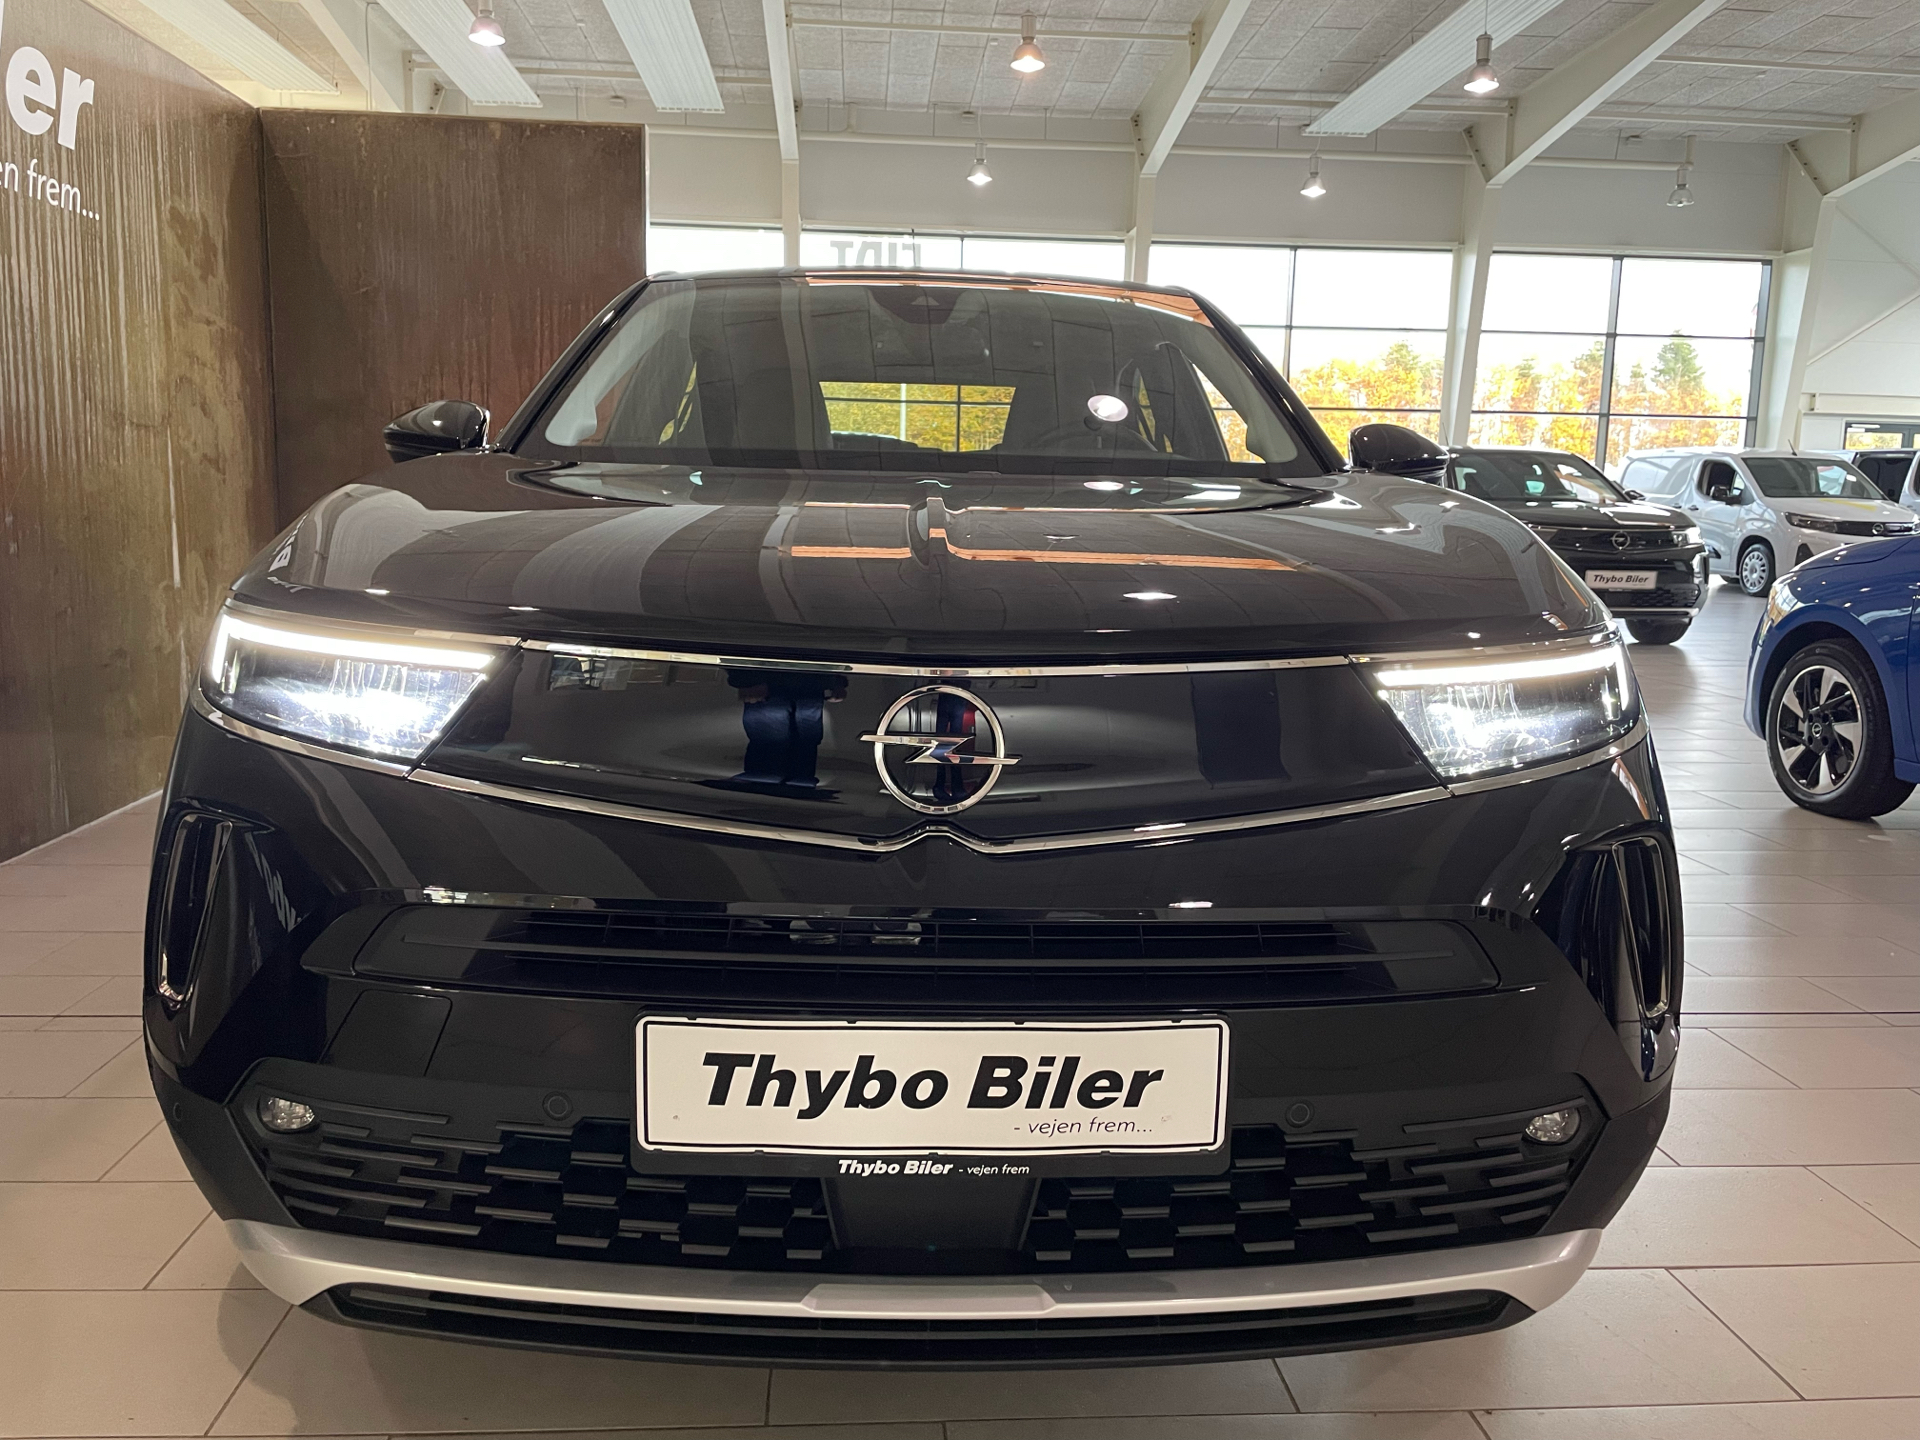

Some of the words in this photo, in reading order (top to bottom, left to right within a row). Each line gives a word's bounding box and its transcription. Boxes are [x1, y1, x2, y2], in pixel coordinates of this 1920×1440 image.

[0, 0, 95, 150] er
[27, 158, 100, 221] frem...
[1593, 574, 1623, 584] Thybo
[1625, 575, 1649, 583] Biler
[702, 1051, 949, 1120] Thybo
[966, 1055, 1164, 1110] Biler
[1028, 1118, 1082, 1138] vejen
[1089, 1116, 1153, 1133] frem...
[838, 1159, 900, 1177] Thybo
[903, 1160, 954, 1175] Biler
[967, 1164, 999, 1176] vejen
[1001, 1164, 1030, 1174] frem
